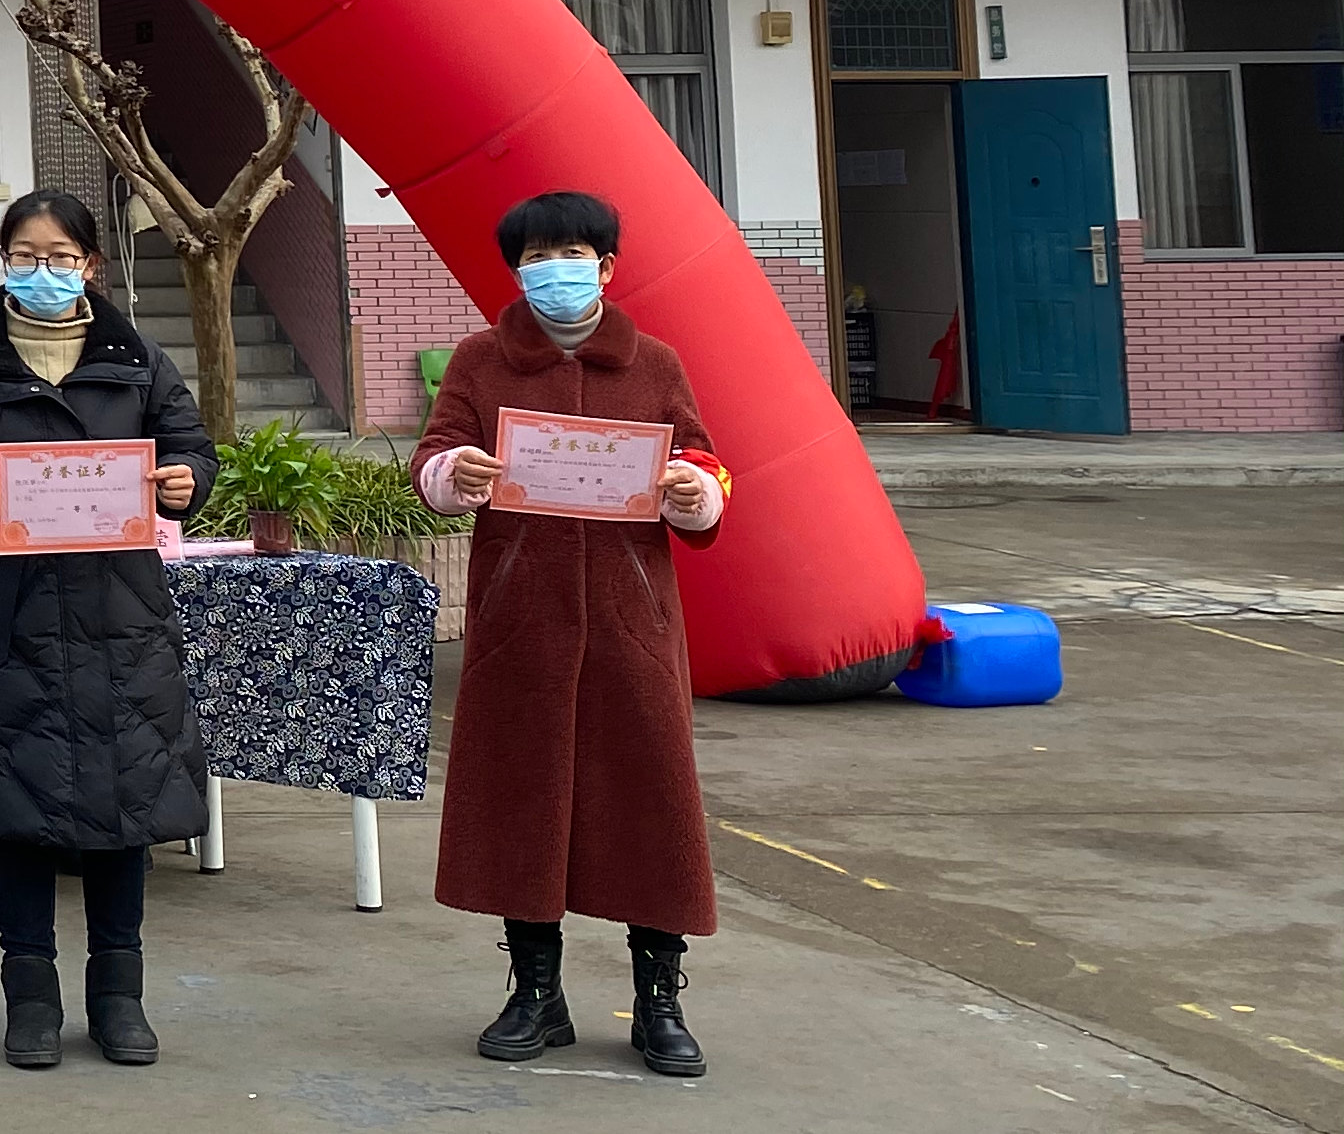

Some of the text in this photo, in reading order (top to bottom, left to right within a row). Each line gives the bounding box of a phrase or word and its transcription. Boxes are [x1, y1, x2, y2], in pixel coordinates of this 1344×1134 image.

[548, 437, 619, 455] 荣誉证书
[41, 463, 107, 480] 荣誉证书
